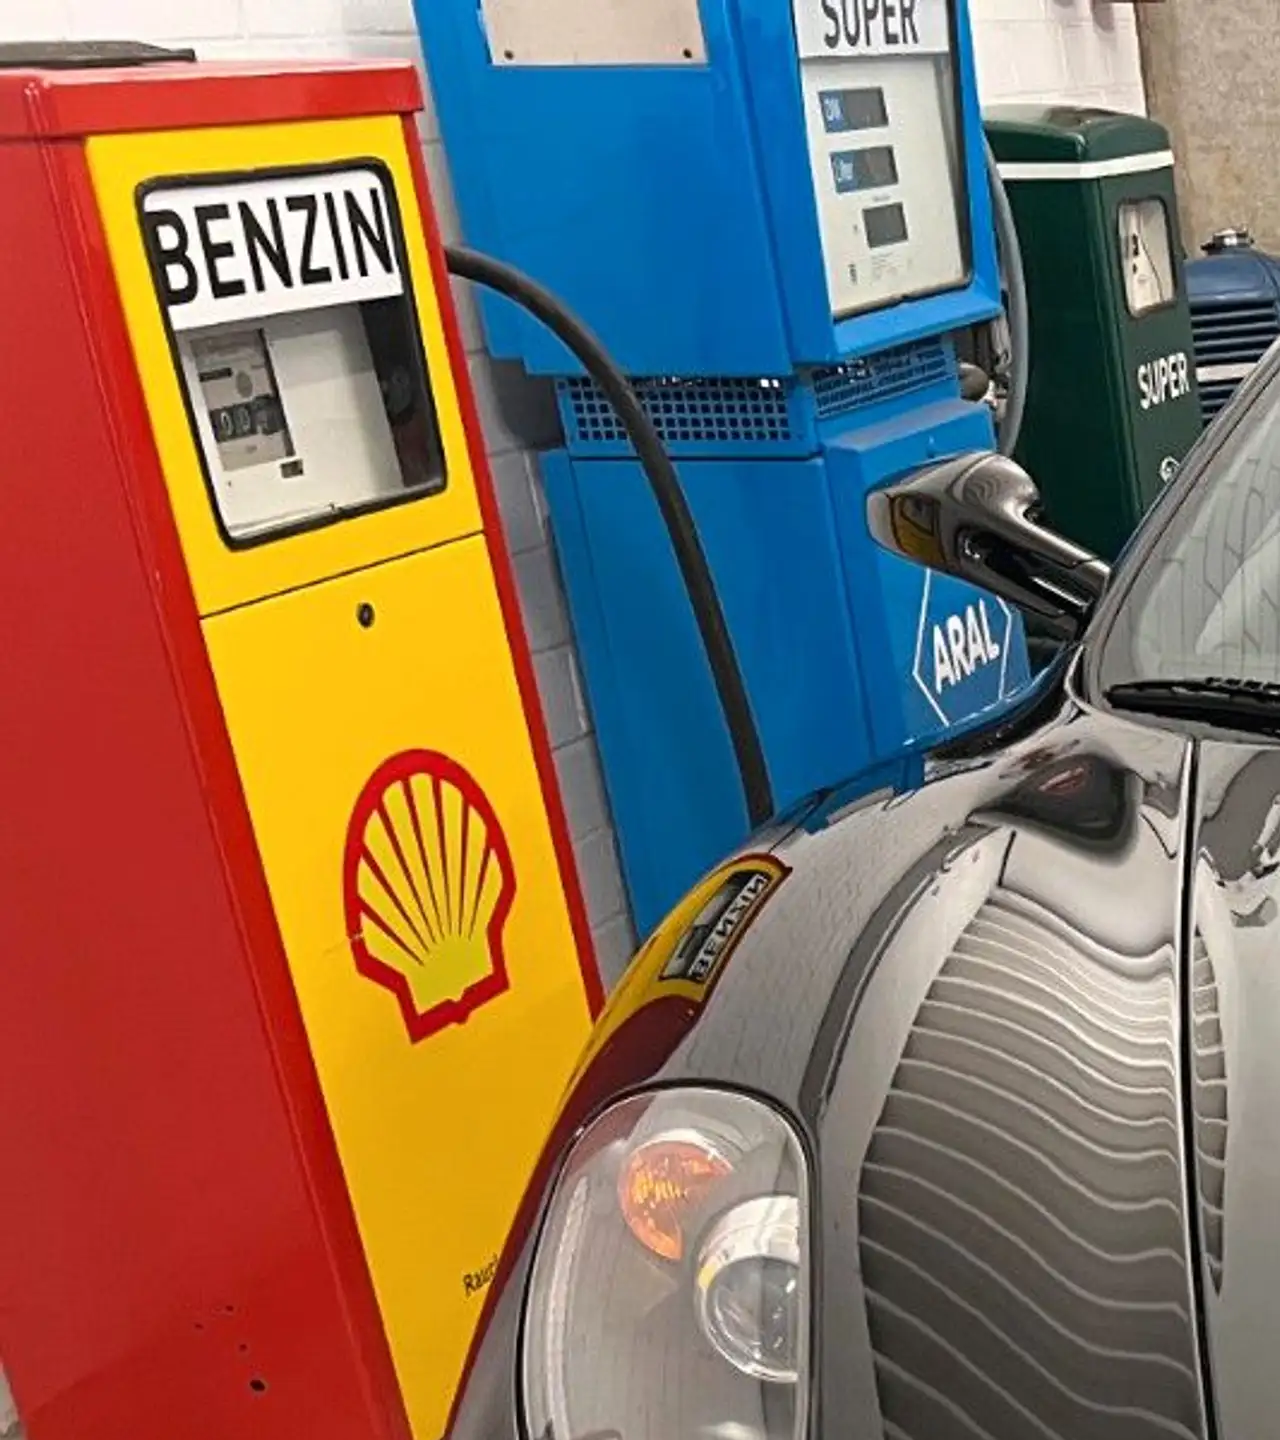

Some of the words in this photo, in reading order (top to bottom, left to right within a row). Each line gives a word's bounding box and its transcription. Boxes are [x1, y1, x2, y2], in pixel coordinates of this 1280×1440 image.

[821, 0, 918, 48] SUPER
[145, 188, 394, 305] BENZIN
[1138, 352, 1191, 409] SUPER
[933, 597, 1000, 695] ARAL
